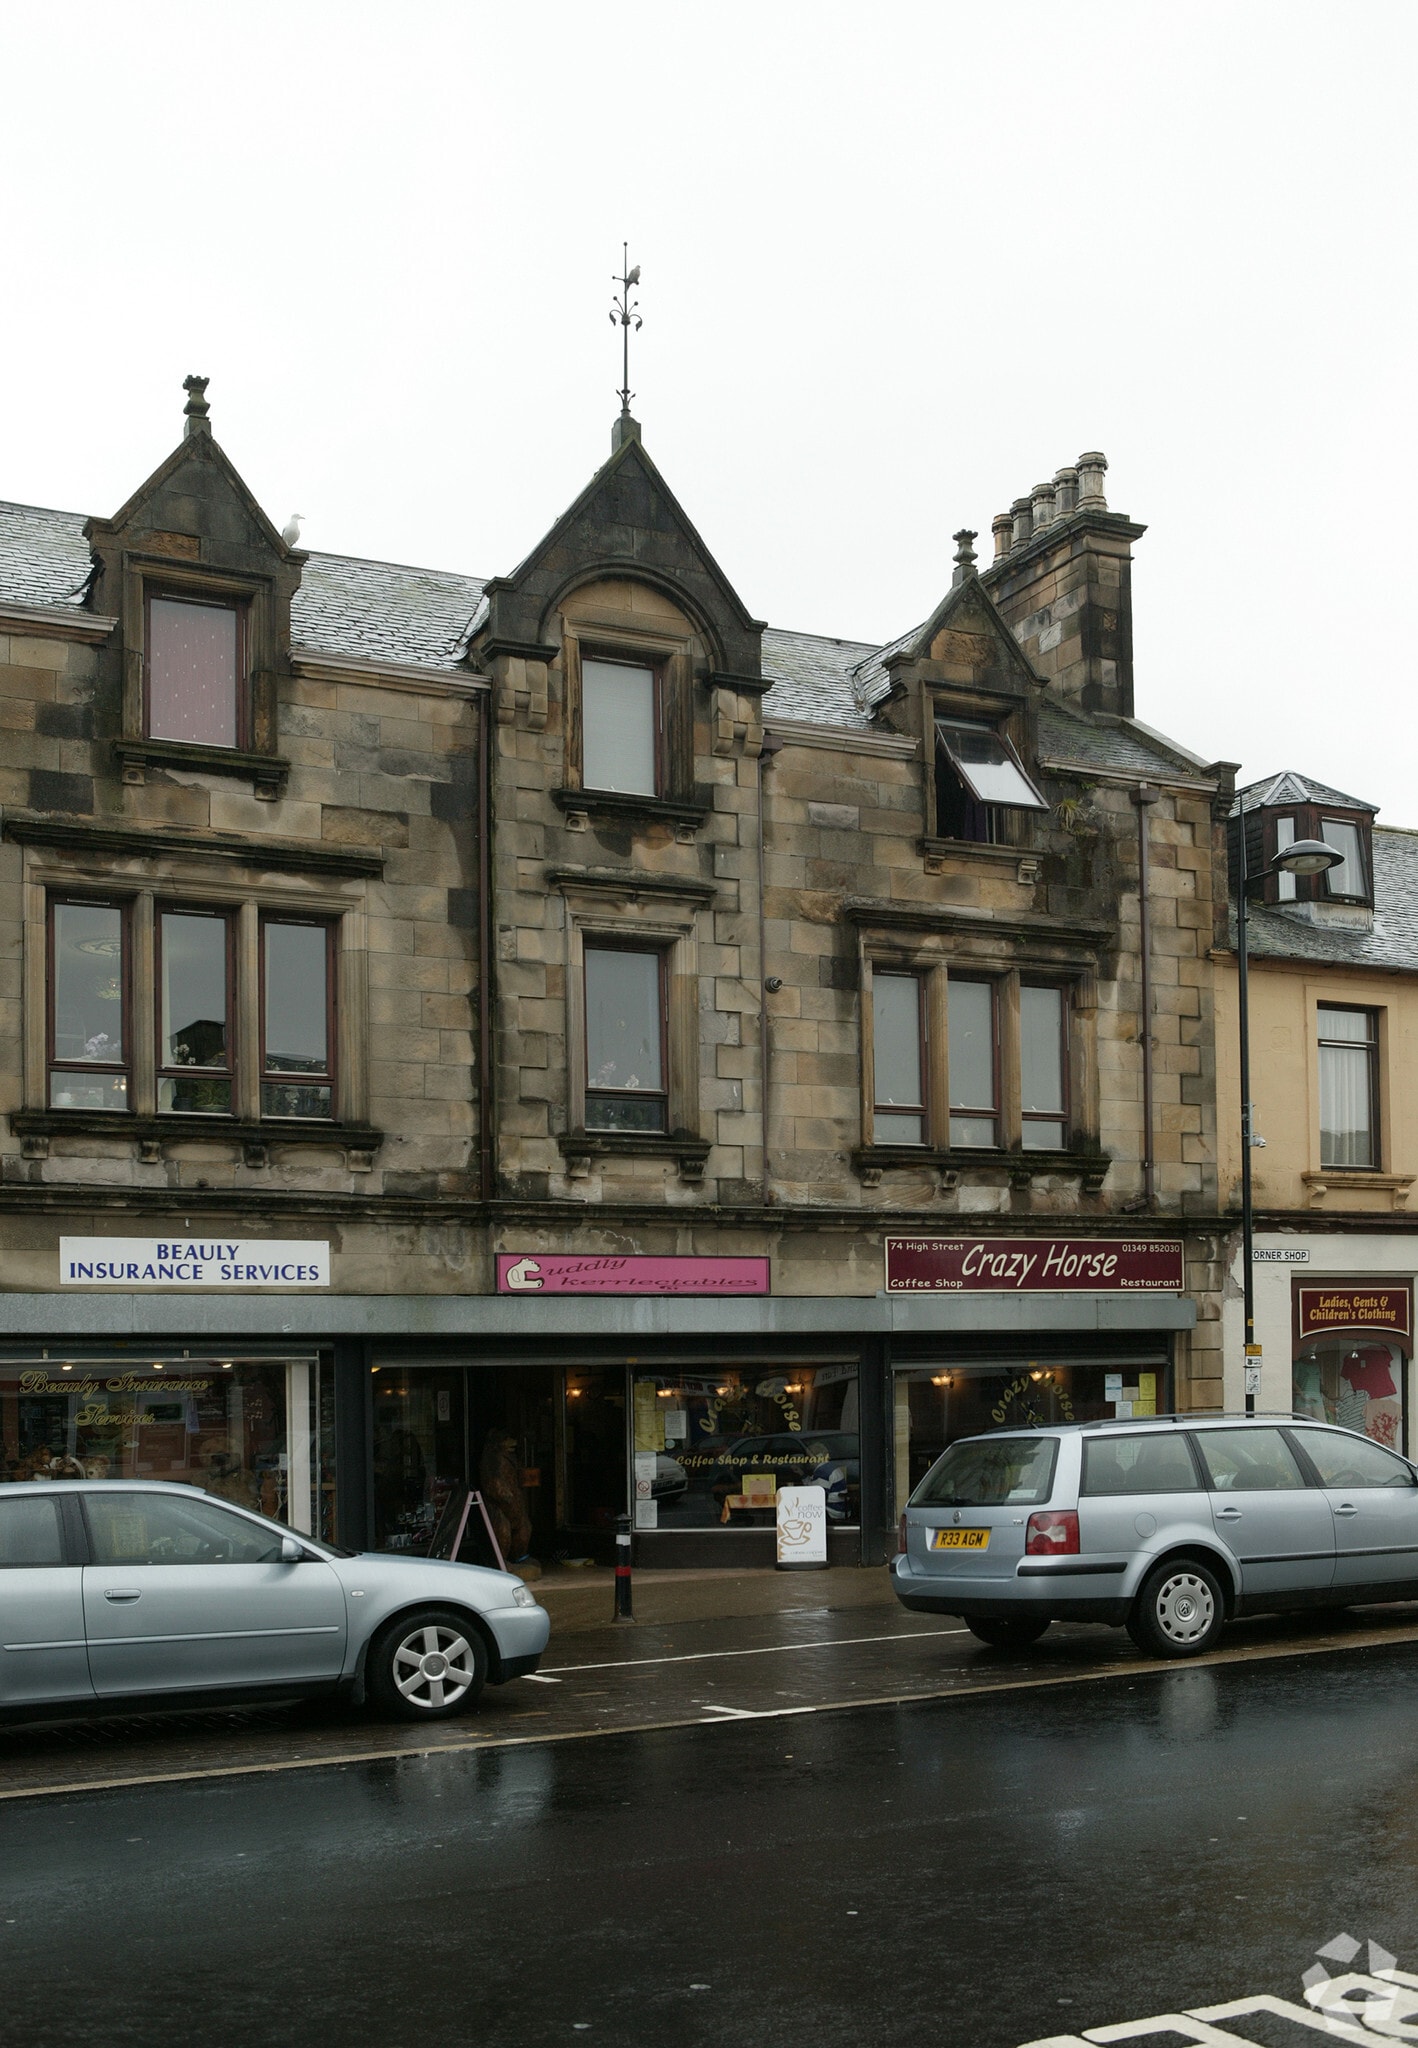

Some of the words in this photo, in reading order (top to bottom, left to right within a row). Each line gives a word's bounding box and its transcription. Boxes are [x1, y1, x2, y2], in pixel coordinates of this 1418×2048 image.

[157, 1243, 239, 1260] BEAULY
[891, 1242, 903, 1251] 74
[906, 1242, 929, 1253] High
[932, 1243, 964, 1251] Street
[1122, 1244, 1147, 1253] 01349
[1149, 1244, 1180, 1253] 852030
[1251, 1250, 1282, 1260] ORNER
[1284, 1251, 1307, 1260] SHOP
[69, 1262, 203, 1279] INSURANCE
[220, 1264, 319, 1280] SERVICES
[961, 1244, 1038, 1287] Crazy
[1041, 1244, 1118, 1277] Horse
[890, 1278, 932, 1288] Coffee
[935, 1278, 963, 1289] Shop
[1120, 1278, 1181, 1287] Restaurant
[1319, 1296, 1351, 1309] Ladies,
[1353, 1296, 1378, 1307] Gents
[1380, 1296, 1388, 1307] &
[1309, 1308, 1356, 1321] Children's
[1358, 1308, 1396, 1322] Clothing
[19, 1370, 100, 1400] Beauly
[105, 1370, 209, 1392] Insurance
[991, 1376, 1031, 1424] Crazy
[74, 1403, 156, 1426] Services
[676, 1455, 715, 1467] Coffee
[717, 1454, 748, 1466] Shop
[751, 1455, 760, 1465] &
[763, 1453, 831, 1465] Restaurant
[798, 1503, 824, 1511] coffee
[797, 1511, 824, 1519] now
[940, 1532, 960, 1546] R33
[961, 1532, 984, 1546] AGM
